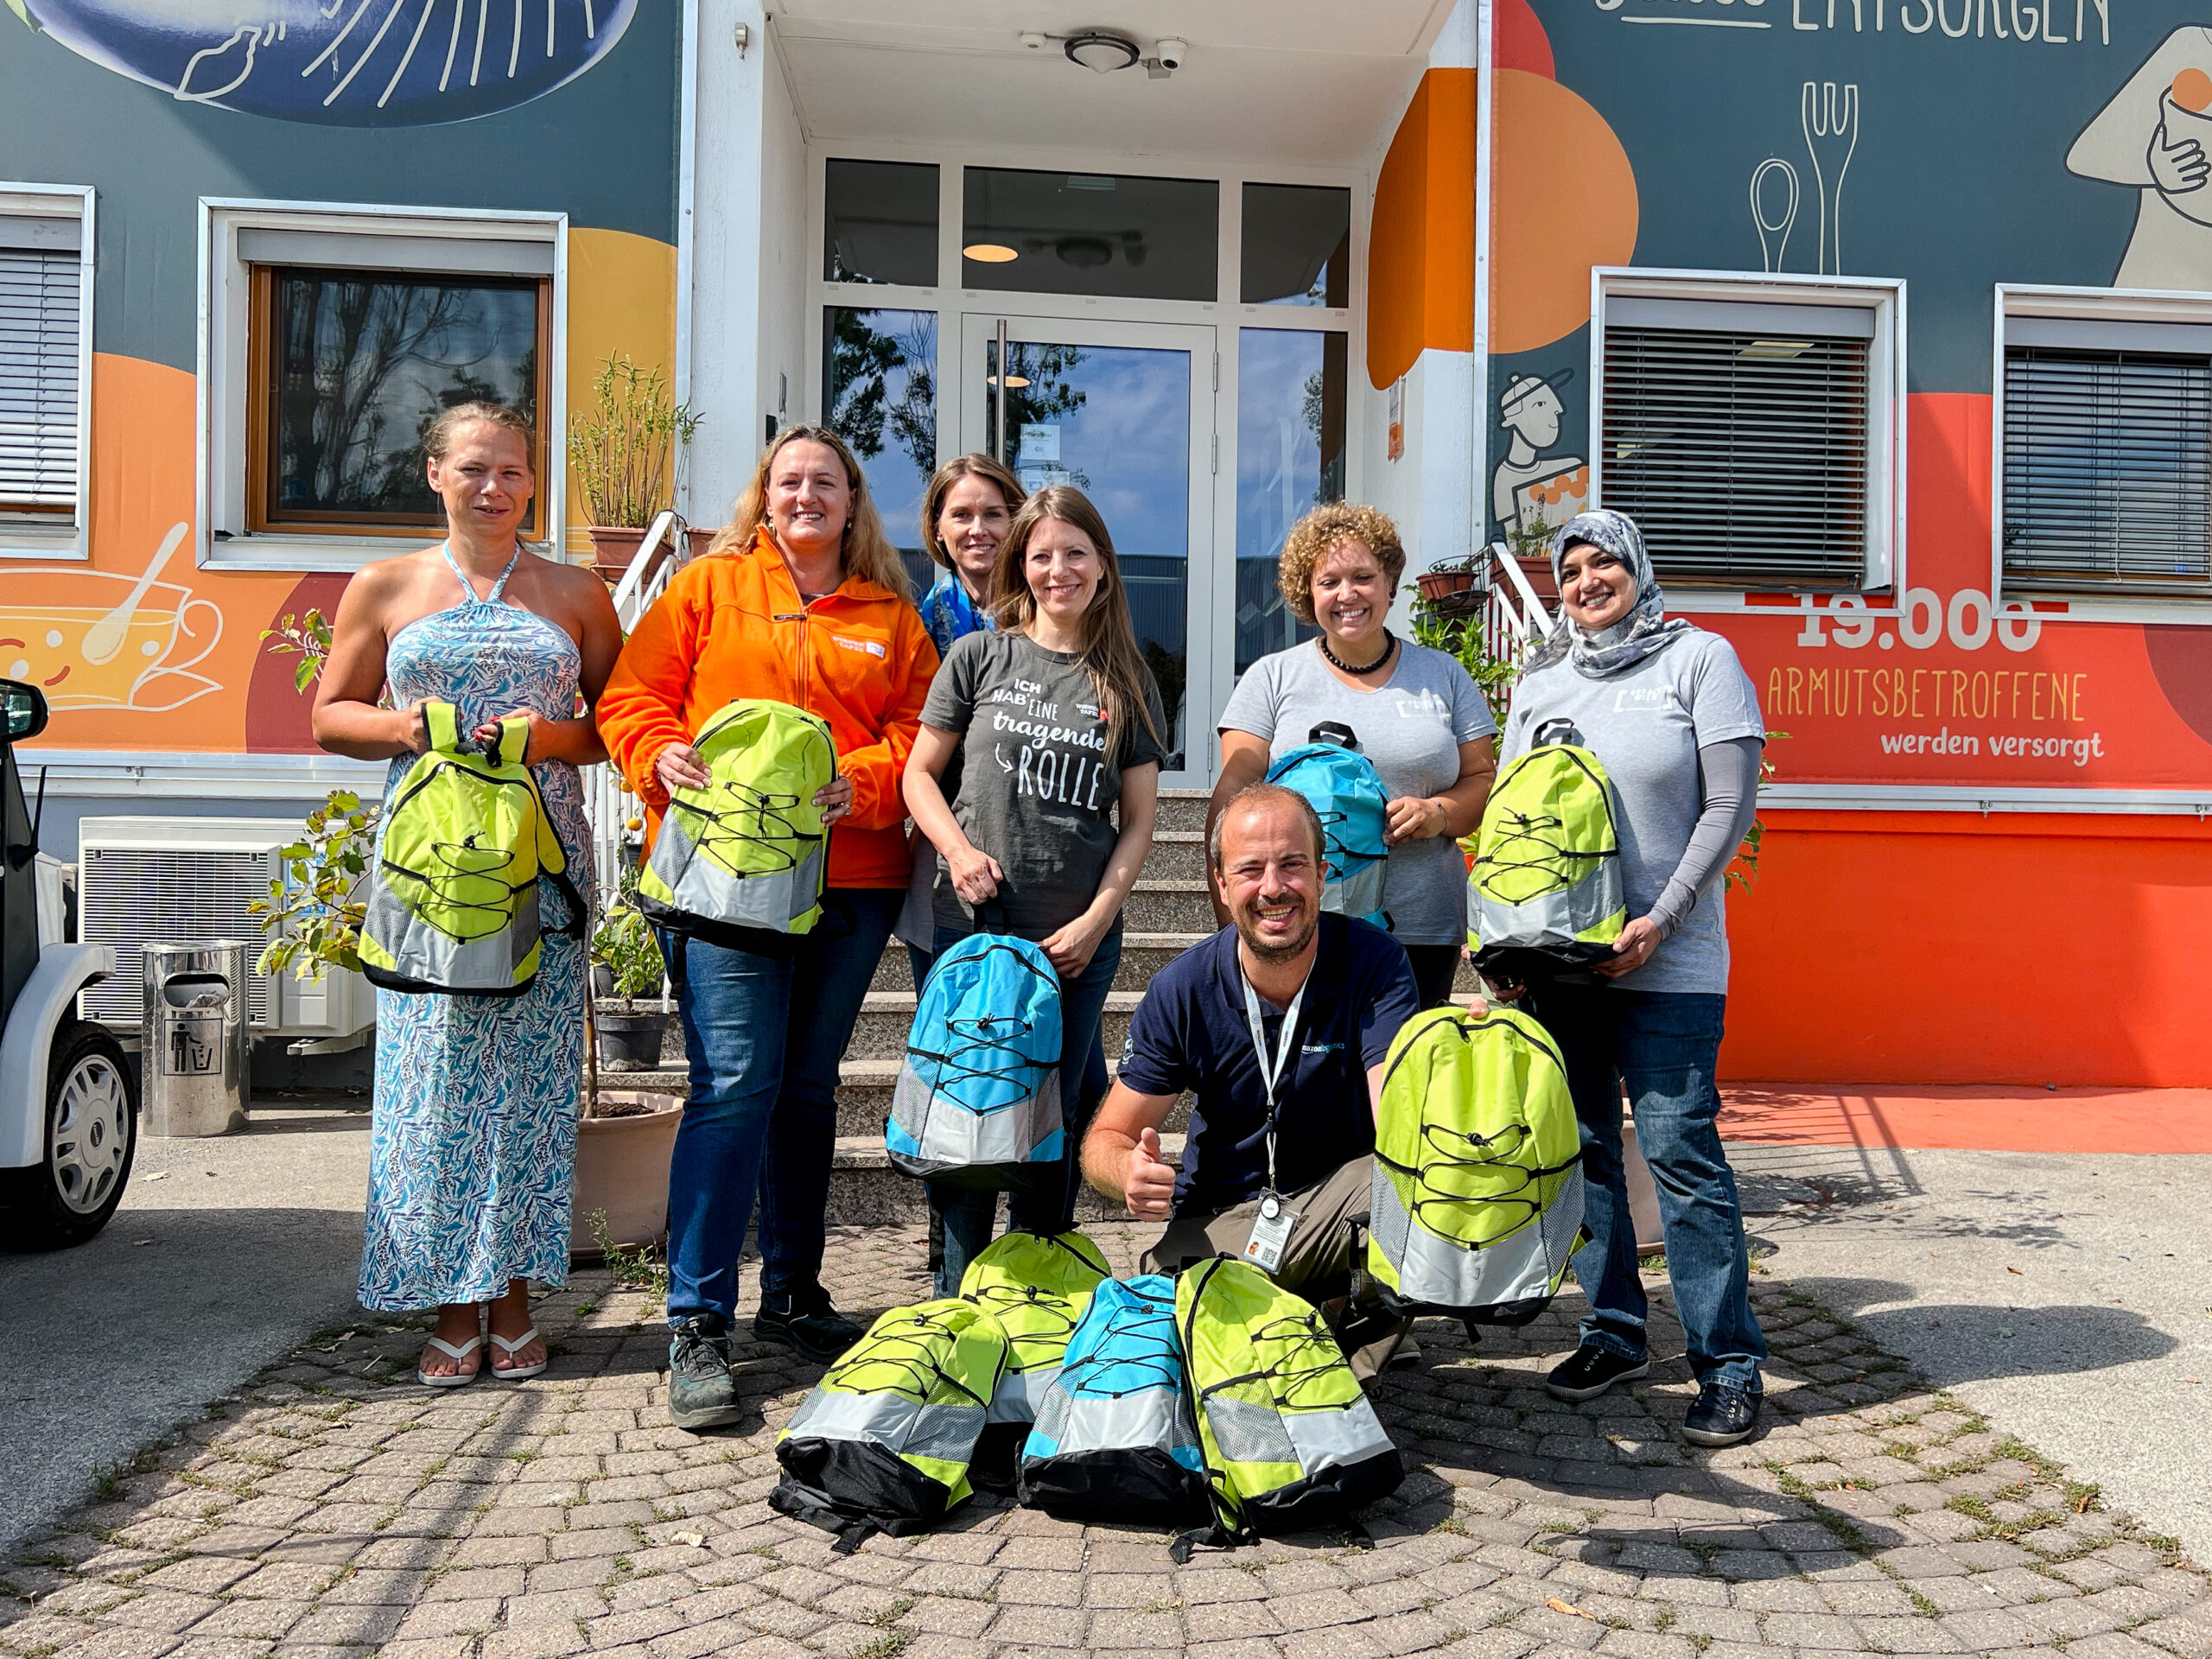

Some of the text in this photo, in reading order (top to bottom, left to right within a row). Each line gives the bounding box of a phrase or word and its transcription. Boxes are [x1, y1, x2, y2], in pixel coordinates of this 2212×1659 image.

[1792, 588, 2042, 652] 19.000
[1014, 678, 1042, 694] ICH
[1767, 666, 2088, 721] ARMUTSBETROFFENE
[994, 710, 1106, 752] tragende
[1027, 699, 1058, 721] EINE
[1880, 727, 2105, 767] werden versorgt
[1017, 745, 1105, 811] ROLLE
